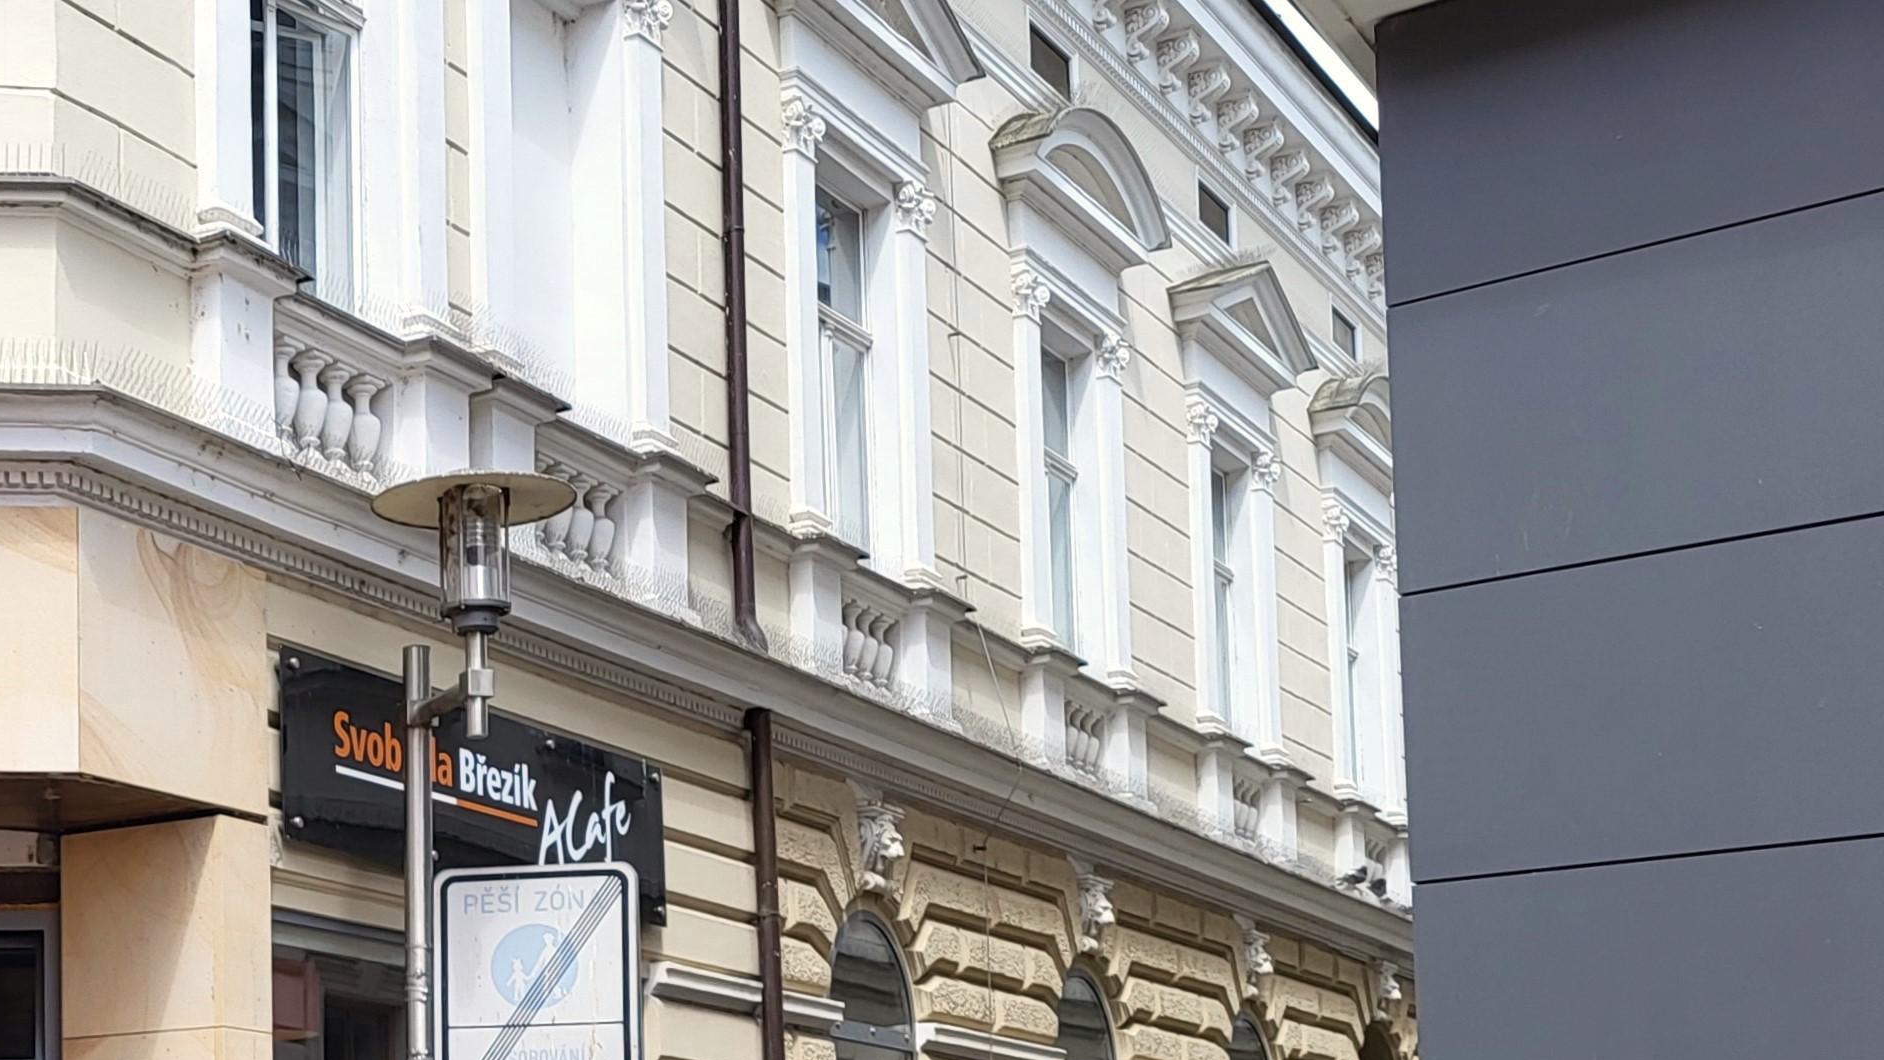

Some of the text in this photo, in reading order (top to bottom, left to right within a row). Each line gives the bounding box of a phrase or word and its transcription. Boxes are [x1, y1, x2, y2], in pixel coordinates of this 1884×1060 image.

[333, 711, 539, 811] Svoba Březík
[463, 883, 592, 915] PĚŠÍ ZÓN
